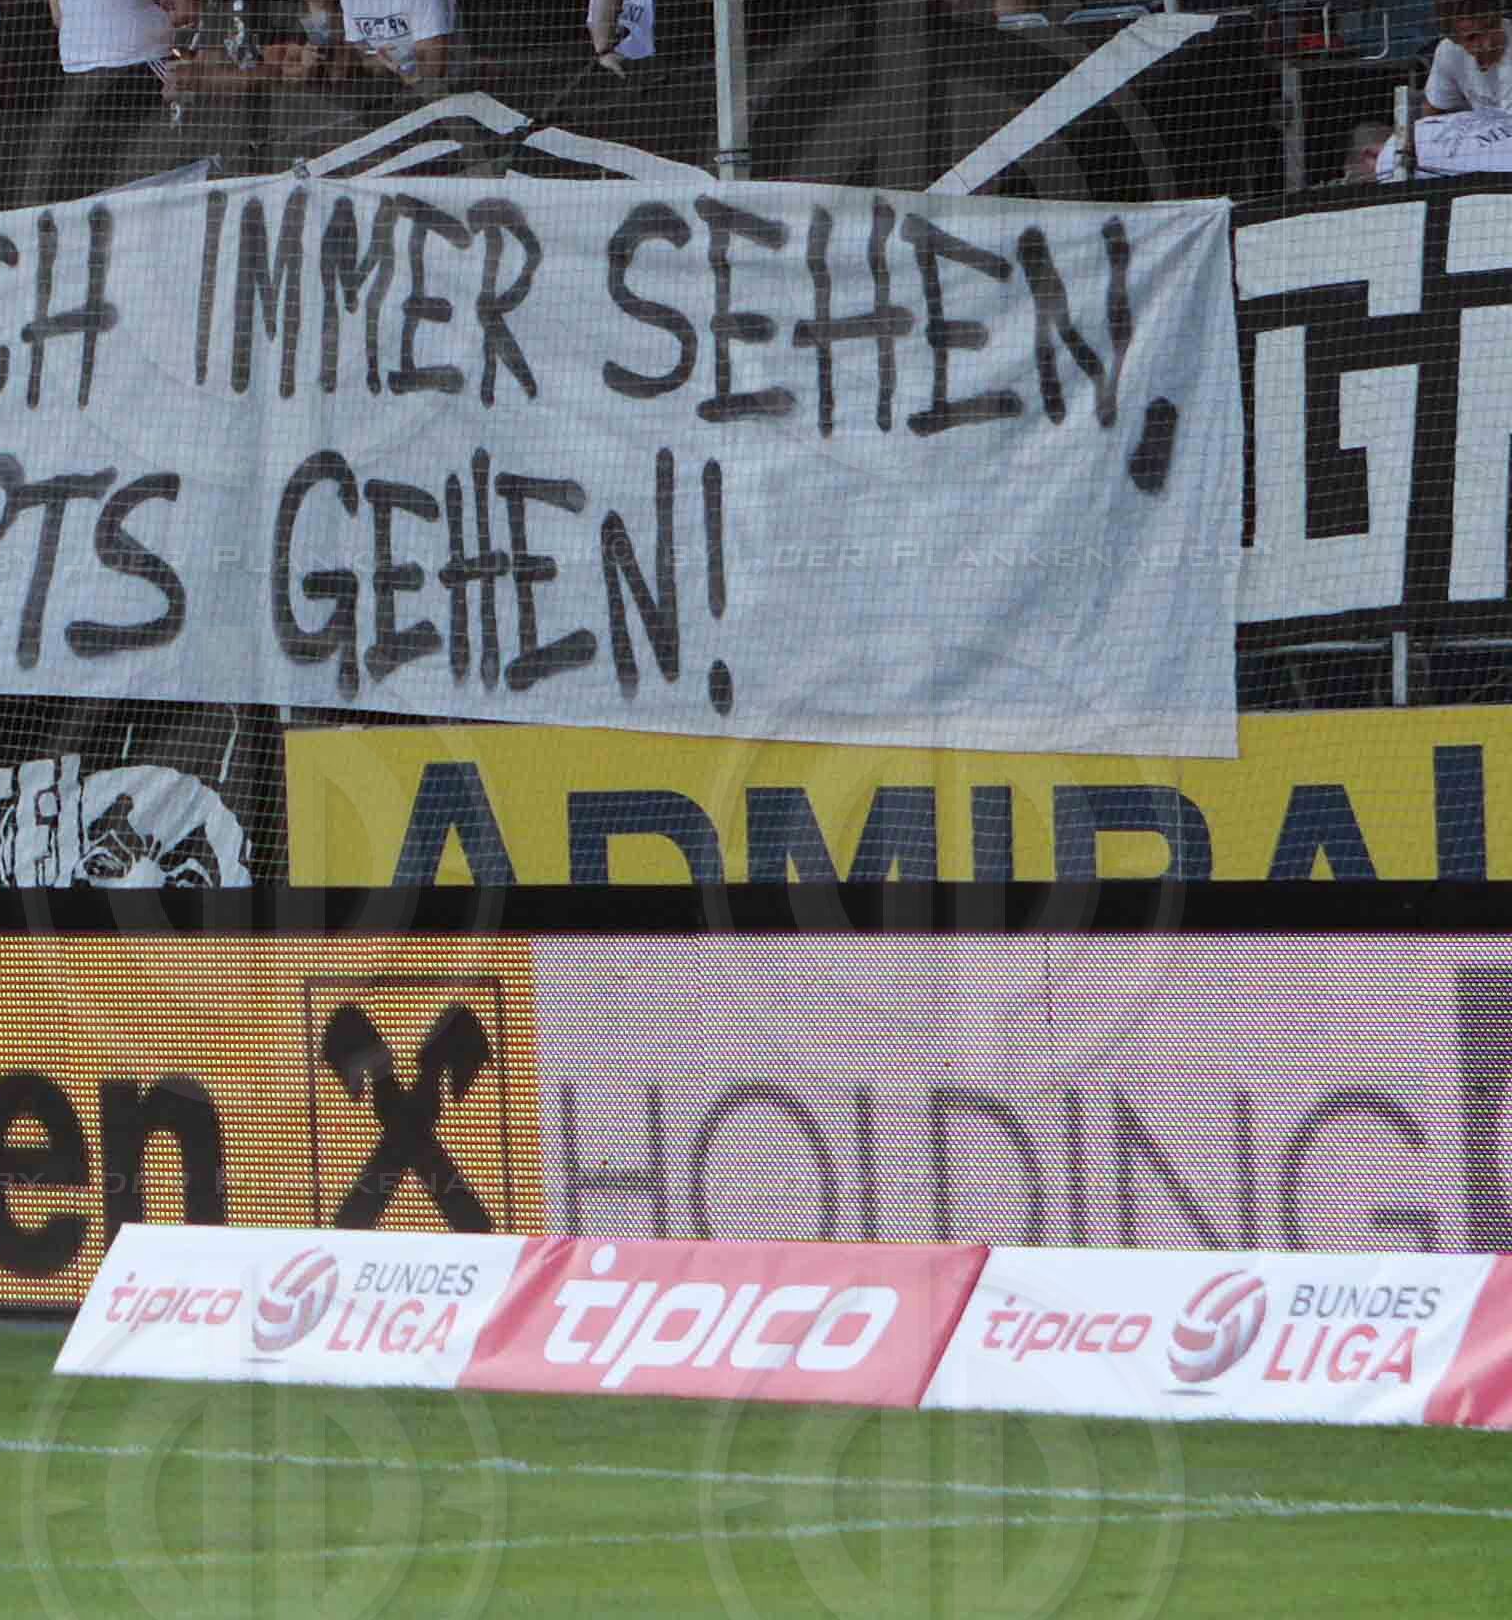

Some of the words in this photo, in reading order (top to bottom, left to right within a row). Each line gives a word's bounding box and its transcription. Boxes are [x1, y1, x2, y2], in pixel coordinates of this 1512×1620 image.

[194, 186, 542, 408] IMMER
[603, 197, 1179, 495] SEHEN,
[282, 445, 736, 718] GEHEN!
[106, 1271, 241, 1335] tipico
[354, 1261, 480, 1298] BUNDES
[1288, 1283, 1440, 1323] BUNDES
[326, 1296, 458, 1353] LIGA
[542, 1246, 899, 1389] tipico
[983, 1295, 1153, 1364] tipico
[1262, 1322, 1418, 1383] LIGA
